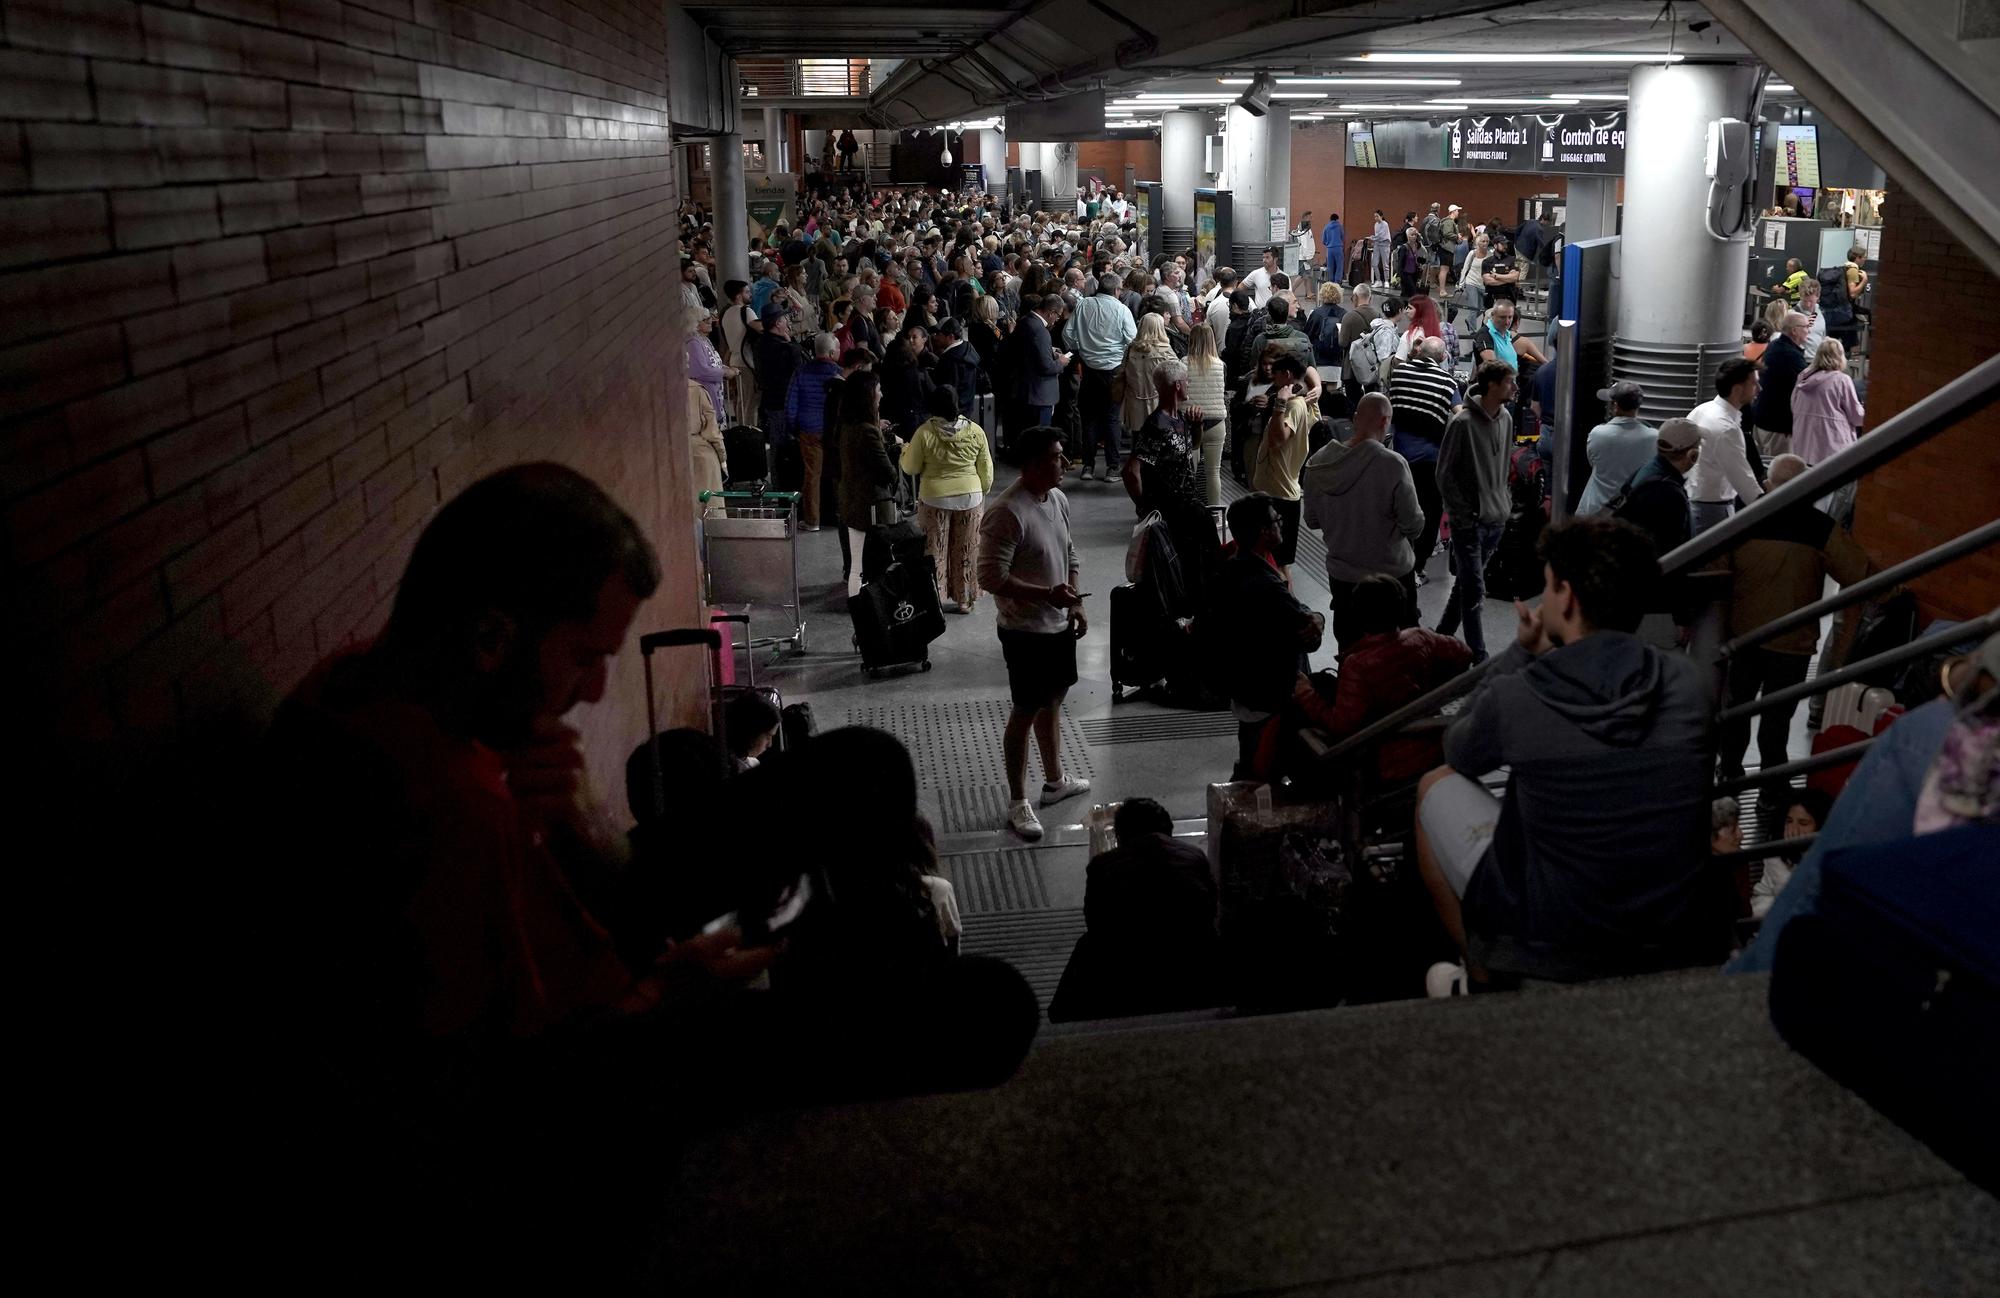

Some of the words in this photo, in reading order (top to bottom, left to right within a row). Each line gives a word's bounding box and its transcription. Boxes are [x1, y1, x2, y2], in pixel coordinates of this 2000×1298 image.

[1467, 128, 1493, 145] Salidas
[1495, 128, 1519, 145] Planta
[1522, 128, 1528, 144] 1
[1561, 128, 1593, 145] Control
[1596, 128, 1608, 145] de
[1467, 151, 1491, 160] DEPARTURES
[1491, 152, 1504, 160] FLOOR
[1561, 152, 1583, 162] LUGGAGE
[1584, 152, 1607, 162] CONTROL
